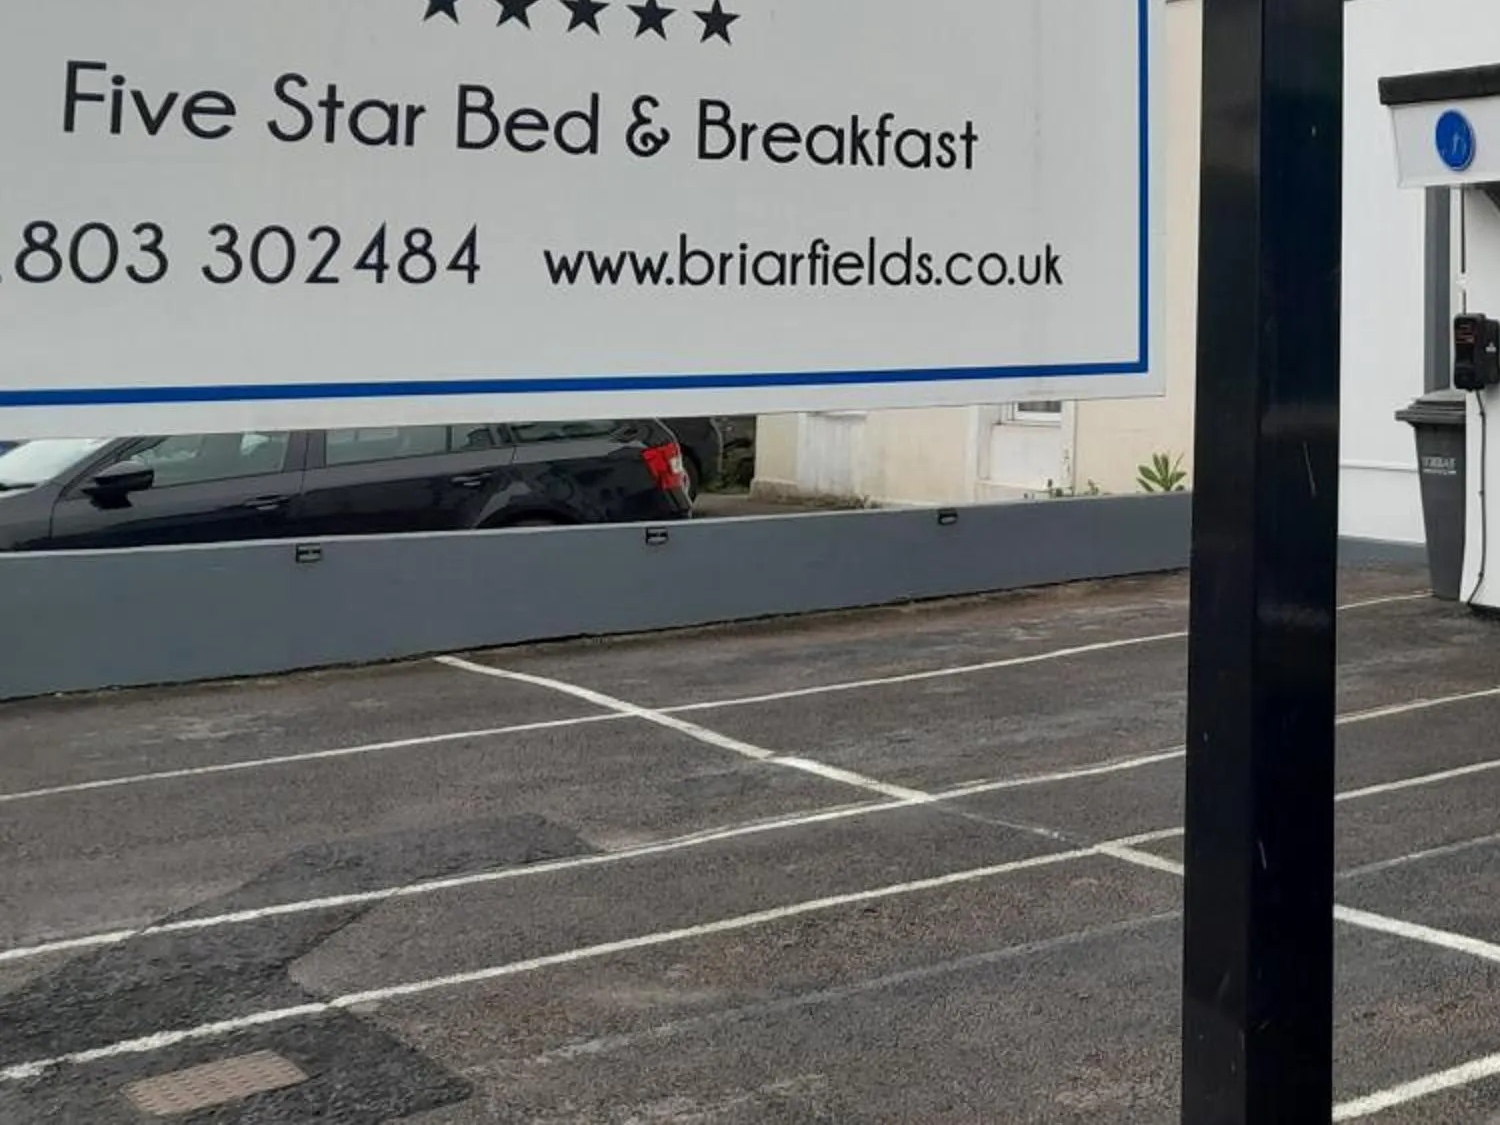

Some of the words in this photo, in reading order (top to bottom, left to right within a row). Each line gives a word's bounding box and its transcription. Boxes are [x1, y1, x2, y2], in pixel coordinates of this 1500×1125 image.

[62, 60, 237, 140] Five
[267, 72, 427, 148] Star
[456, 84, 600, 156] Bed
[625, 94, 672, 158] &
[697, 98, 979, 170] Breakfast
[0, 219, 169, 285] 803
[201, 221, 481, 286] 302484
[543, 232, 1063, 287] www.briarfields.co.uk
